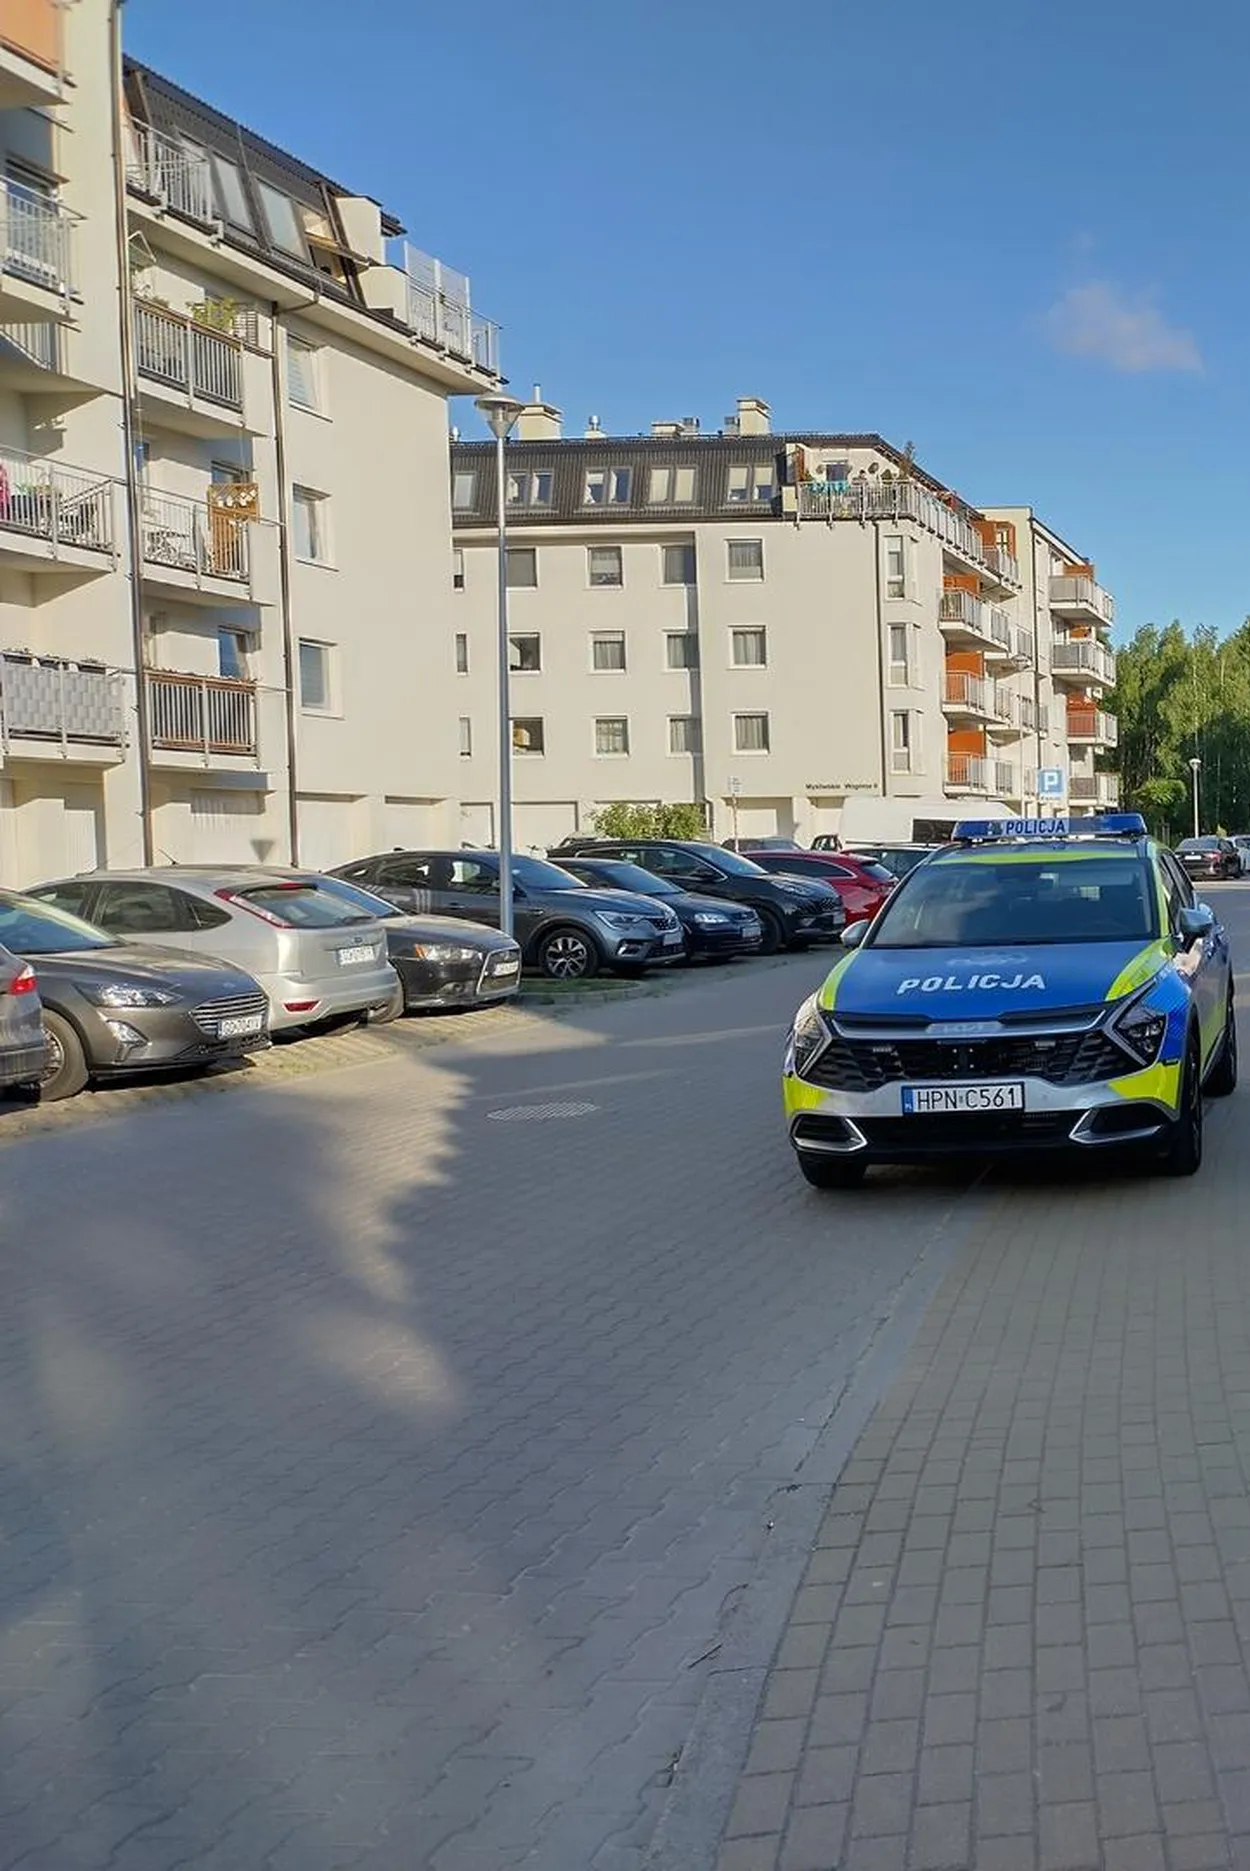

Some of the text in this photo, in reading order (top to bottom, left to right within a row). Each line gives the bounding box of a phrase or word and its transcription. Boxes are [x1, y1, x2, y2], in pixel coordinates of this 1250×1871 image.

[1006, 820, 1066, 835] POLICJA
[896, 973, 1046, 995] POLICJA
[917, 1087, 1015, 1110] HPN C561
